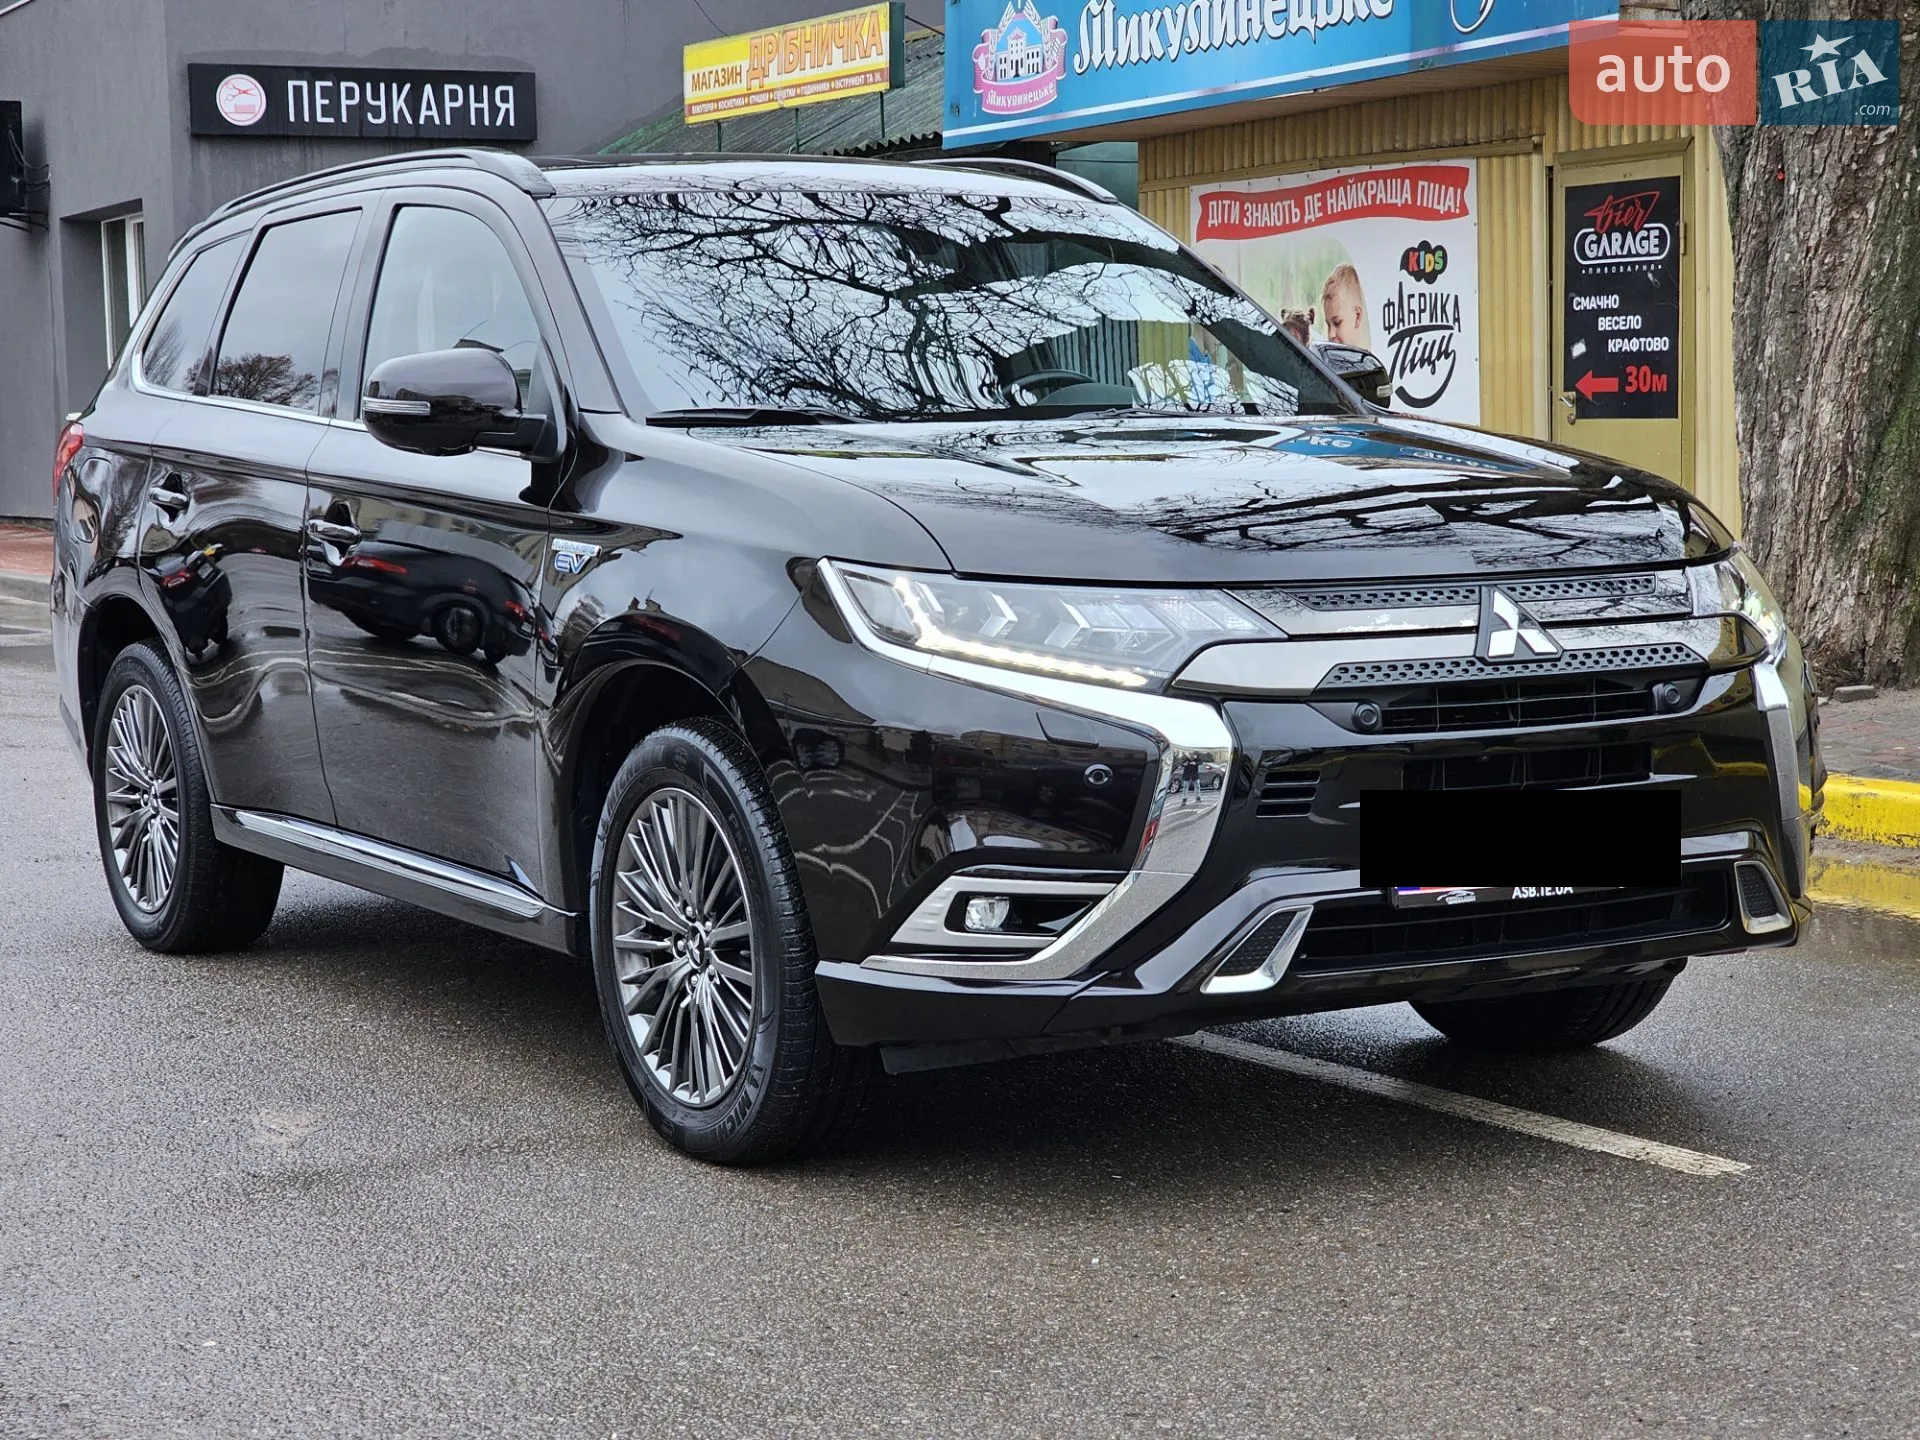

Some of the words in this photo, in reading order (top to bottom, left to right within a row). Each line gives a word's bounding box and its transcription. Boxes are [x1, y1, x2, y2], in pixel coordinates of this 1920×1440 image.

[746, 11, 884, 90] ДРІБНИЧКА
[691, 64, 742, 92] МАГАЗИН
[287, 80, 516, 127] ПЕРУКАРНЯ
[1207, 199, 1240, 228] ДІТИ
[1243, 200, 1301, 229] ЗНАЮТЬ
[1304, 193, 1323, 224] ДЕ
[1327, 178, 1412, 215] НАЙКРАЩА
[1416, 180, 1462, 215] ПІЦА!
[1584, 229, 1660, 259] GARAGE
[1408, 250, 1444, 273] KIDS
[1382, 281, 1462, 334] ФАБРИКА
[1573, 294, 1619, 311] СМАЧНО
[1598, 315, 1642, 331] ВЕСЕЛО
[1608, 336, 1669, 353] КРАФТОВО
[554, 551, 591, 575] EV
